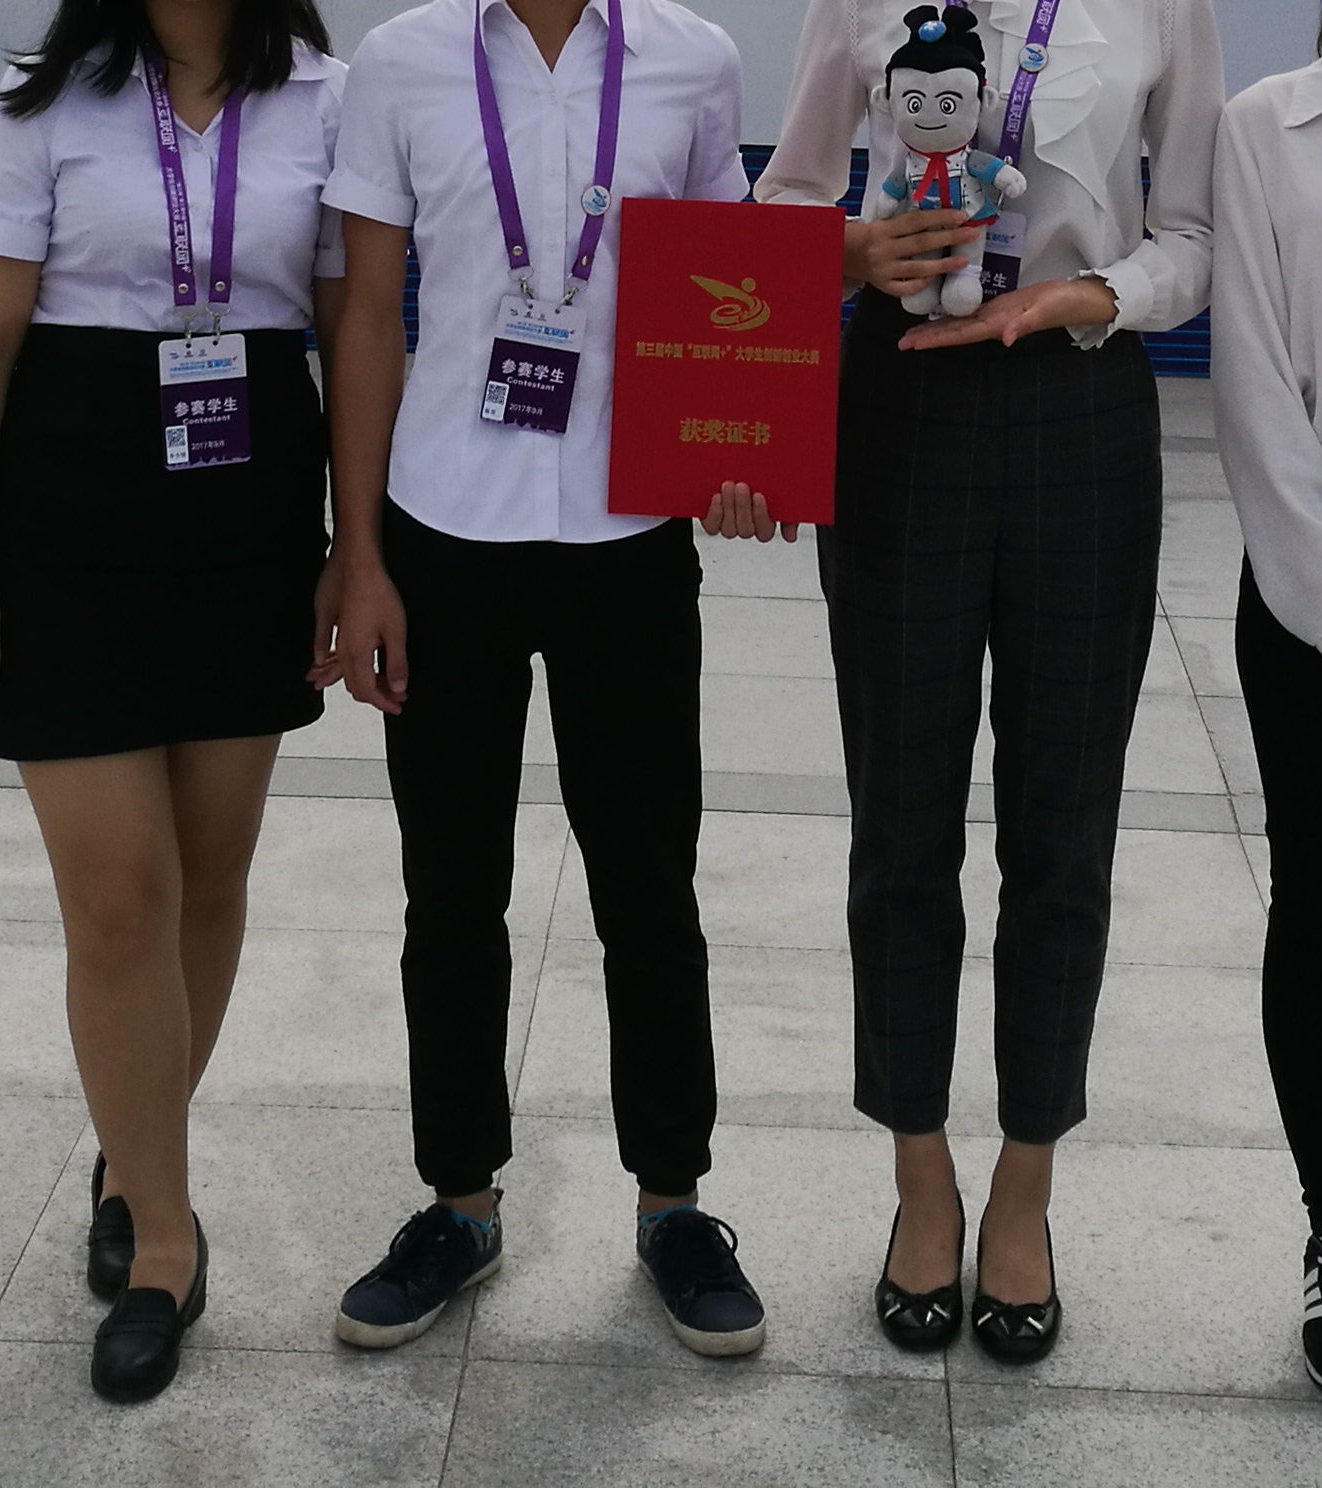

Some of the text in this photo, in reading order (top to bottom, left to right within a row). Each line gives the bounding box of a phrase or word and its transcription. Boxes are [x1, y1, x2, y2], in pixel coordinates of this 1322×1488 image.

[501, 358, 565, 384] 参赛学生
[506, 376, 555, 391] Contestant
[174, 396, 239, 417] 参赛学生
[183, 414, 231, 426] Contestant
[679, 417, 771, 446] 获奖证书
